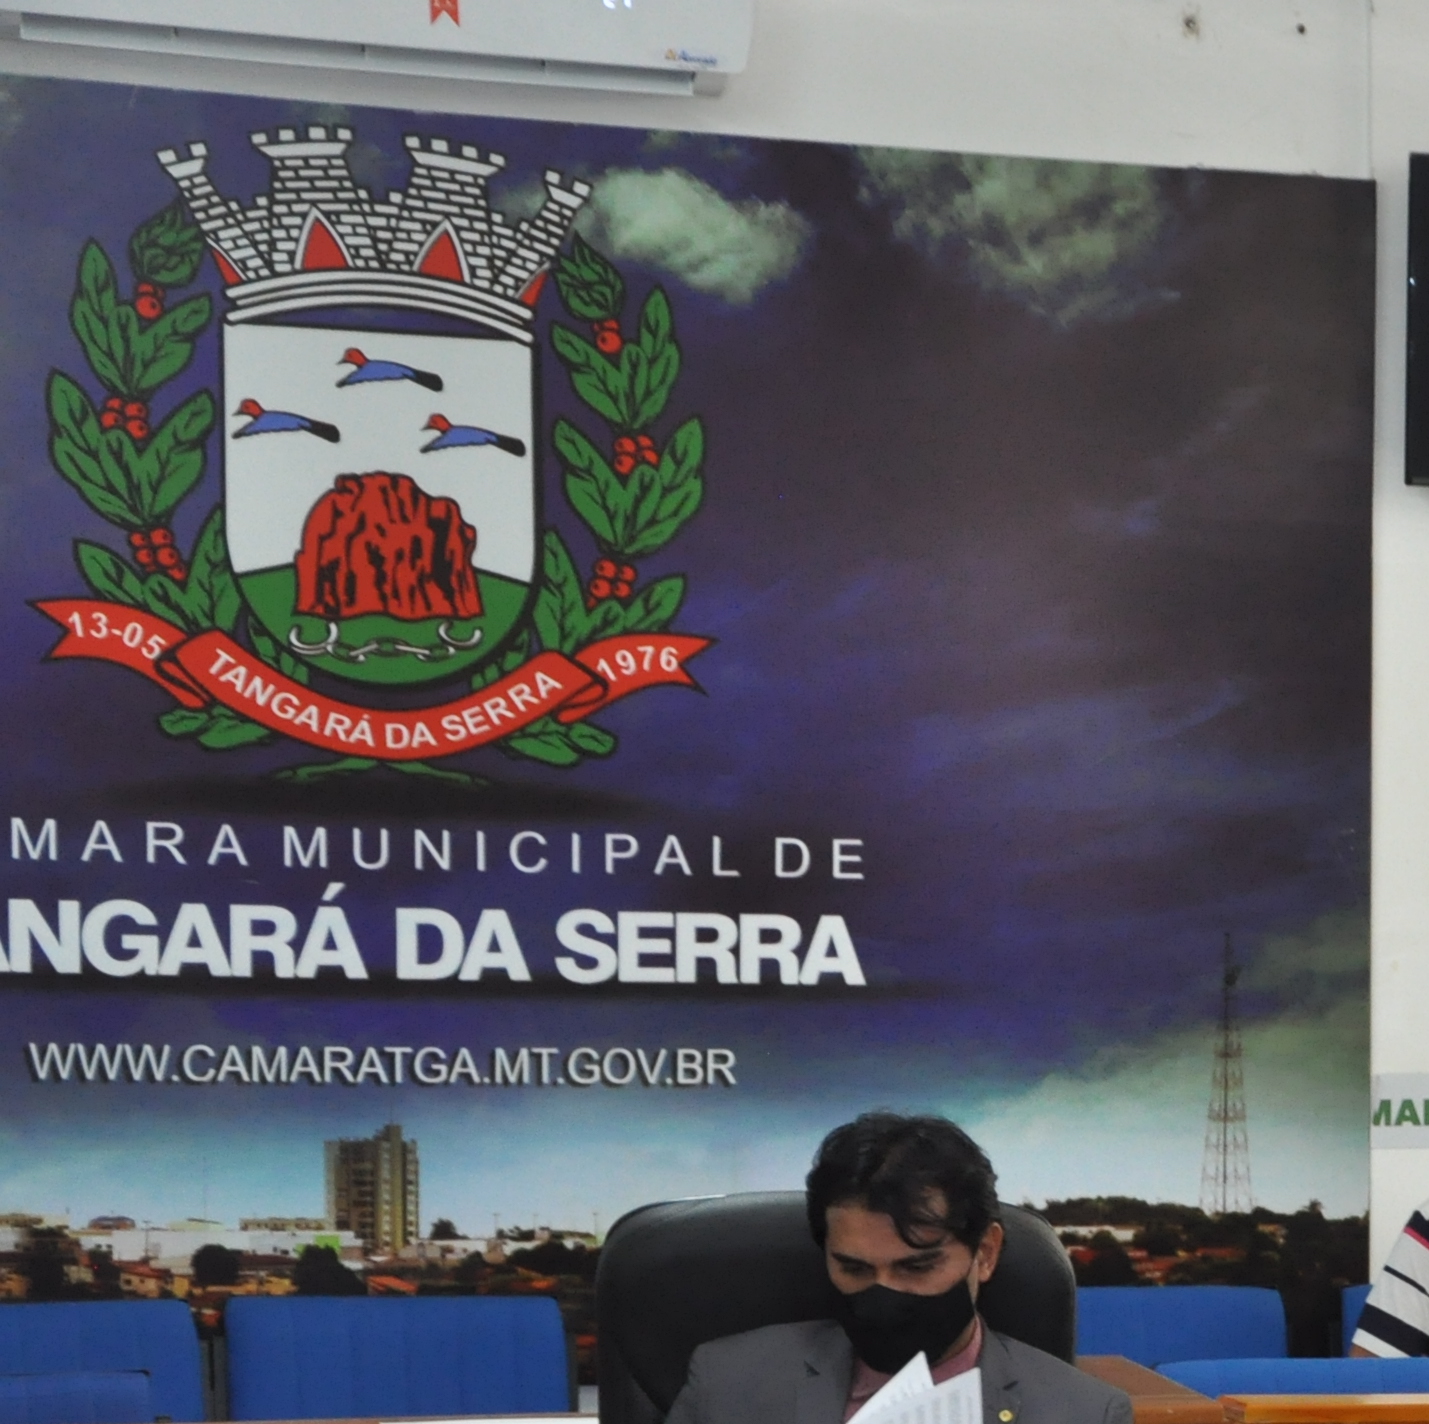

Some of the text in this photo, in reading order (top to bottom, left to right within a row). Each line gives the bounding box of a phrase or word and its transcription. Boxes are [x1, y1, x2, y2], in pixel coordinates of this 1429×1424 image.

[68, 611, 167, 660] 13-05
[597, 645, 679, 682] 1976
[207, 648, 563, 749] TANGARÁ DA SERRA
[10, 817, 864, 880] MARA MUNICIPAL DE
[0, 882, 867, 986] NGARÁ DA SERRA
[28, 1042, 737, 1086] WWW.CAMARATGA.MT.GOV.BR
